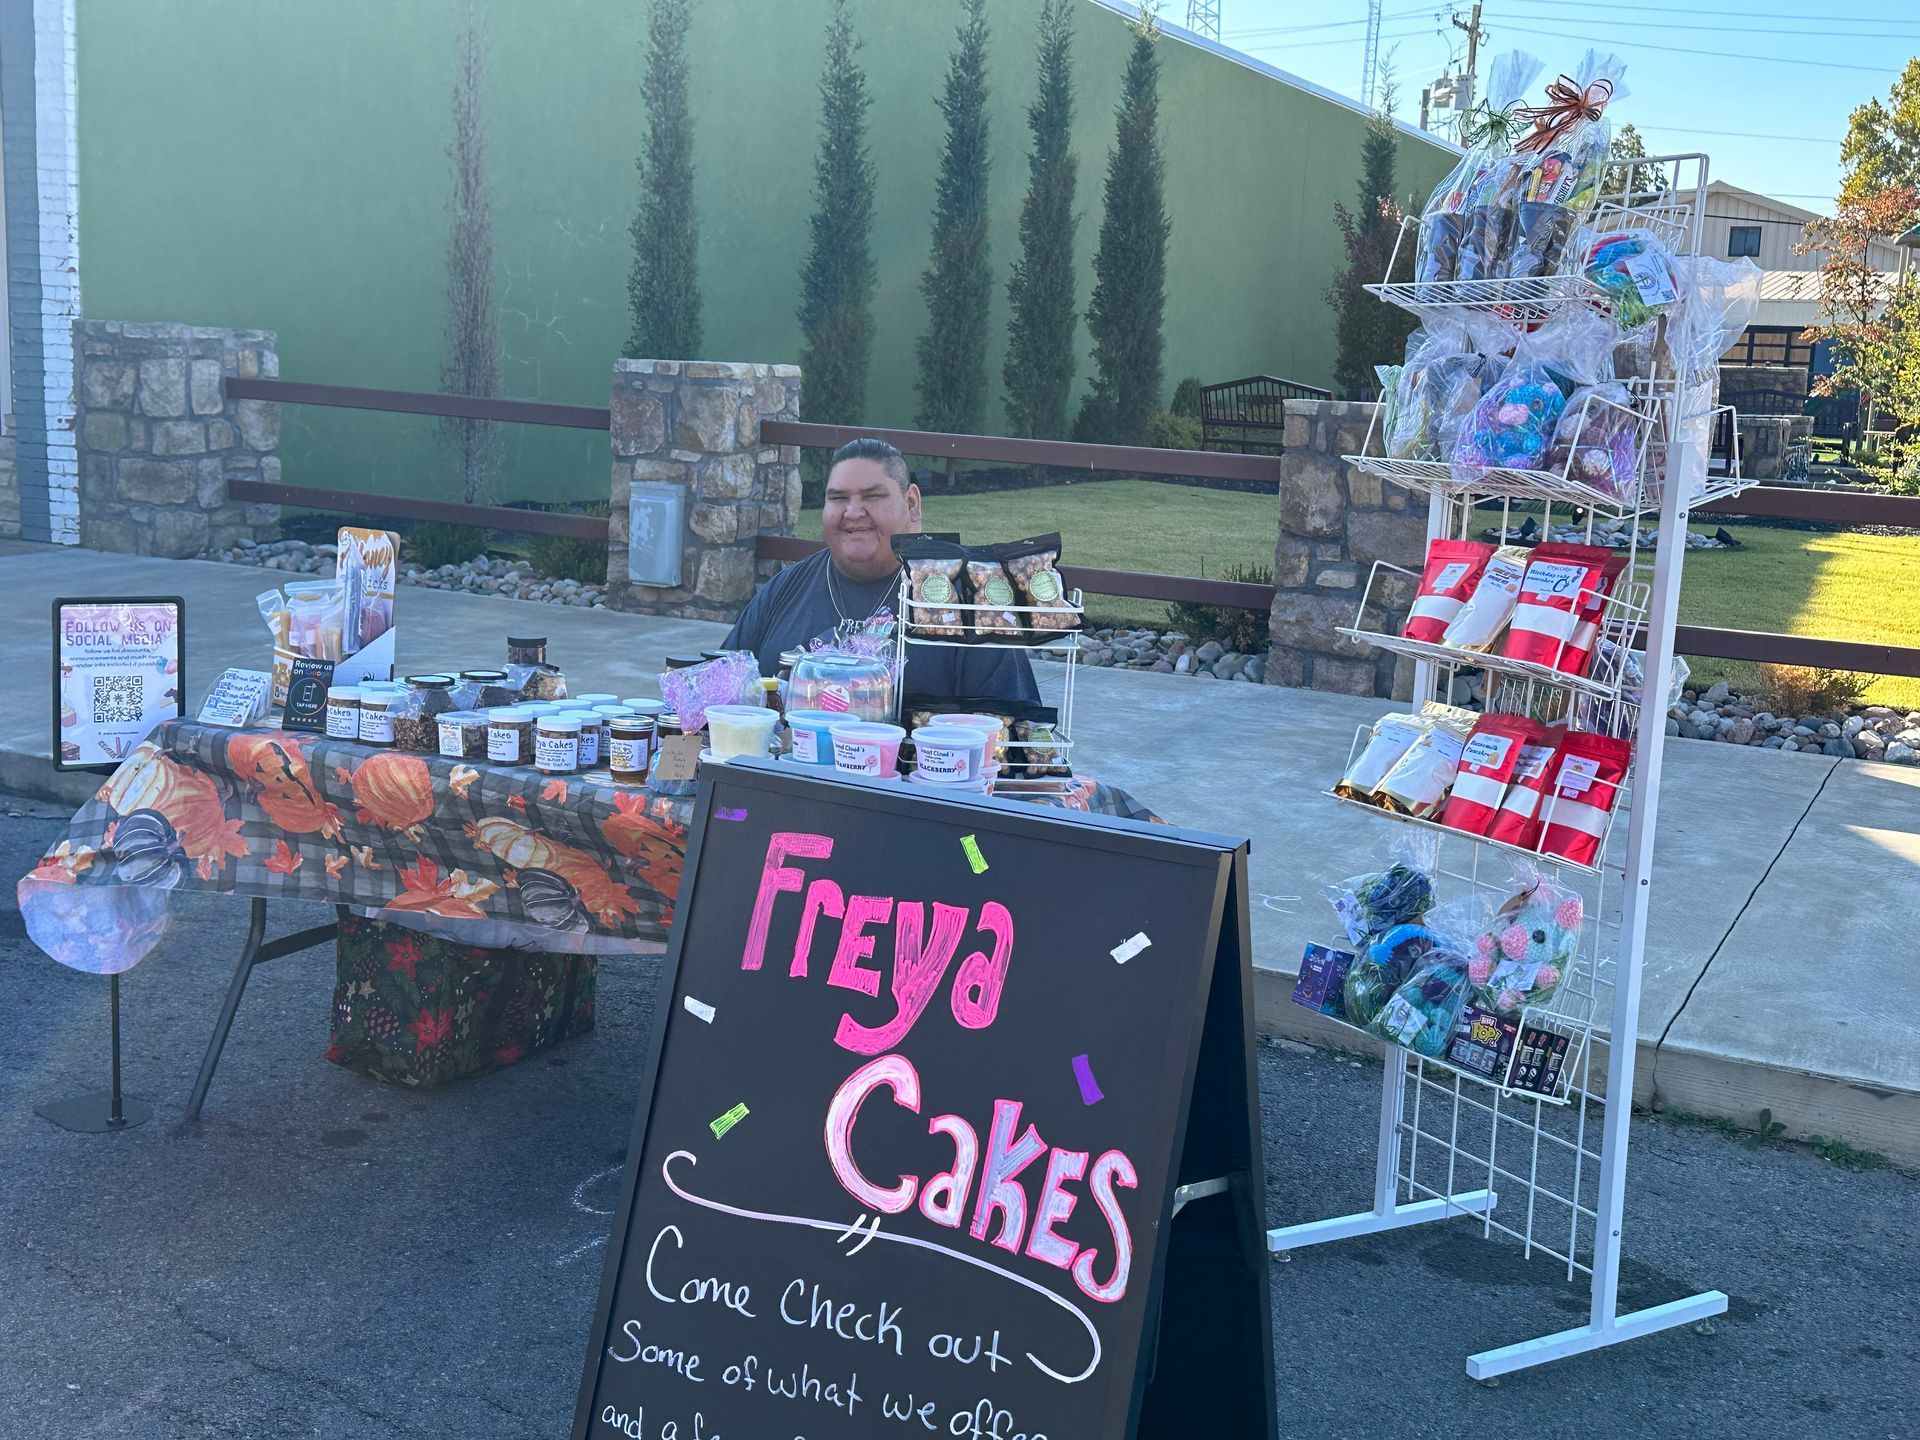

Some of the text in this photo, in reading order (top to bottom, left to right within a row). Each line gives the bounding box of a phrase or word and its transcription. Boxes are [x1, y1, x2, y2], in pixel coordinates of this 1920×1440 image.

[66, 621, 120, 633] FOLLOW
[154, 620, 171, 632] ON
[66, 634, 113, 646] SOCIAL
[295, 660, 323, 670] Review
[548, 740, 574, 750] Cakes
[646, 1225, 1012, 1373] Come Check out
[608, 1320, 704, 1383] Some
[722, 1356, 758, 1399] of
[882, 1393, 938, 1431] we
[949, 1398, 1049, 1440] off
[601, 1405, 643, 1440] and
